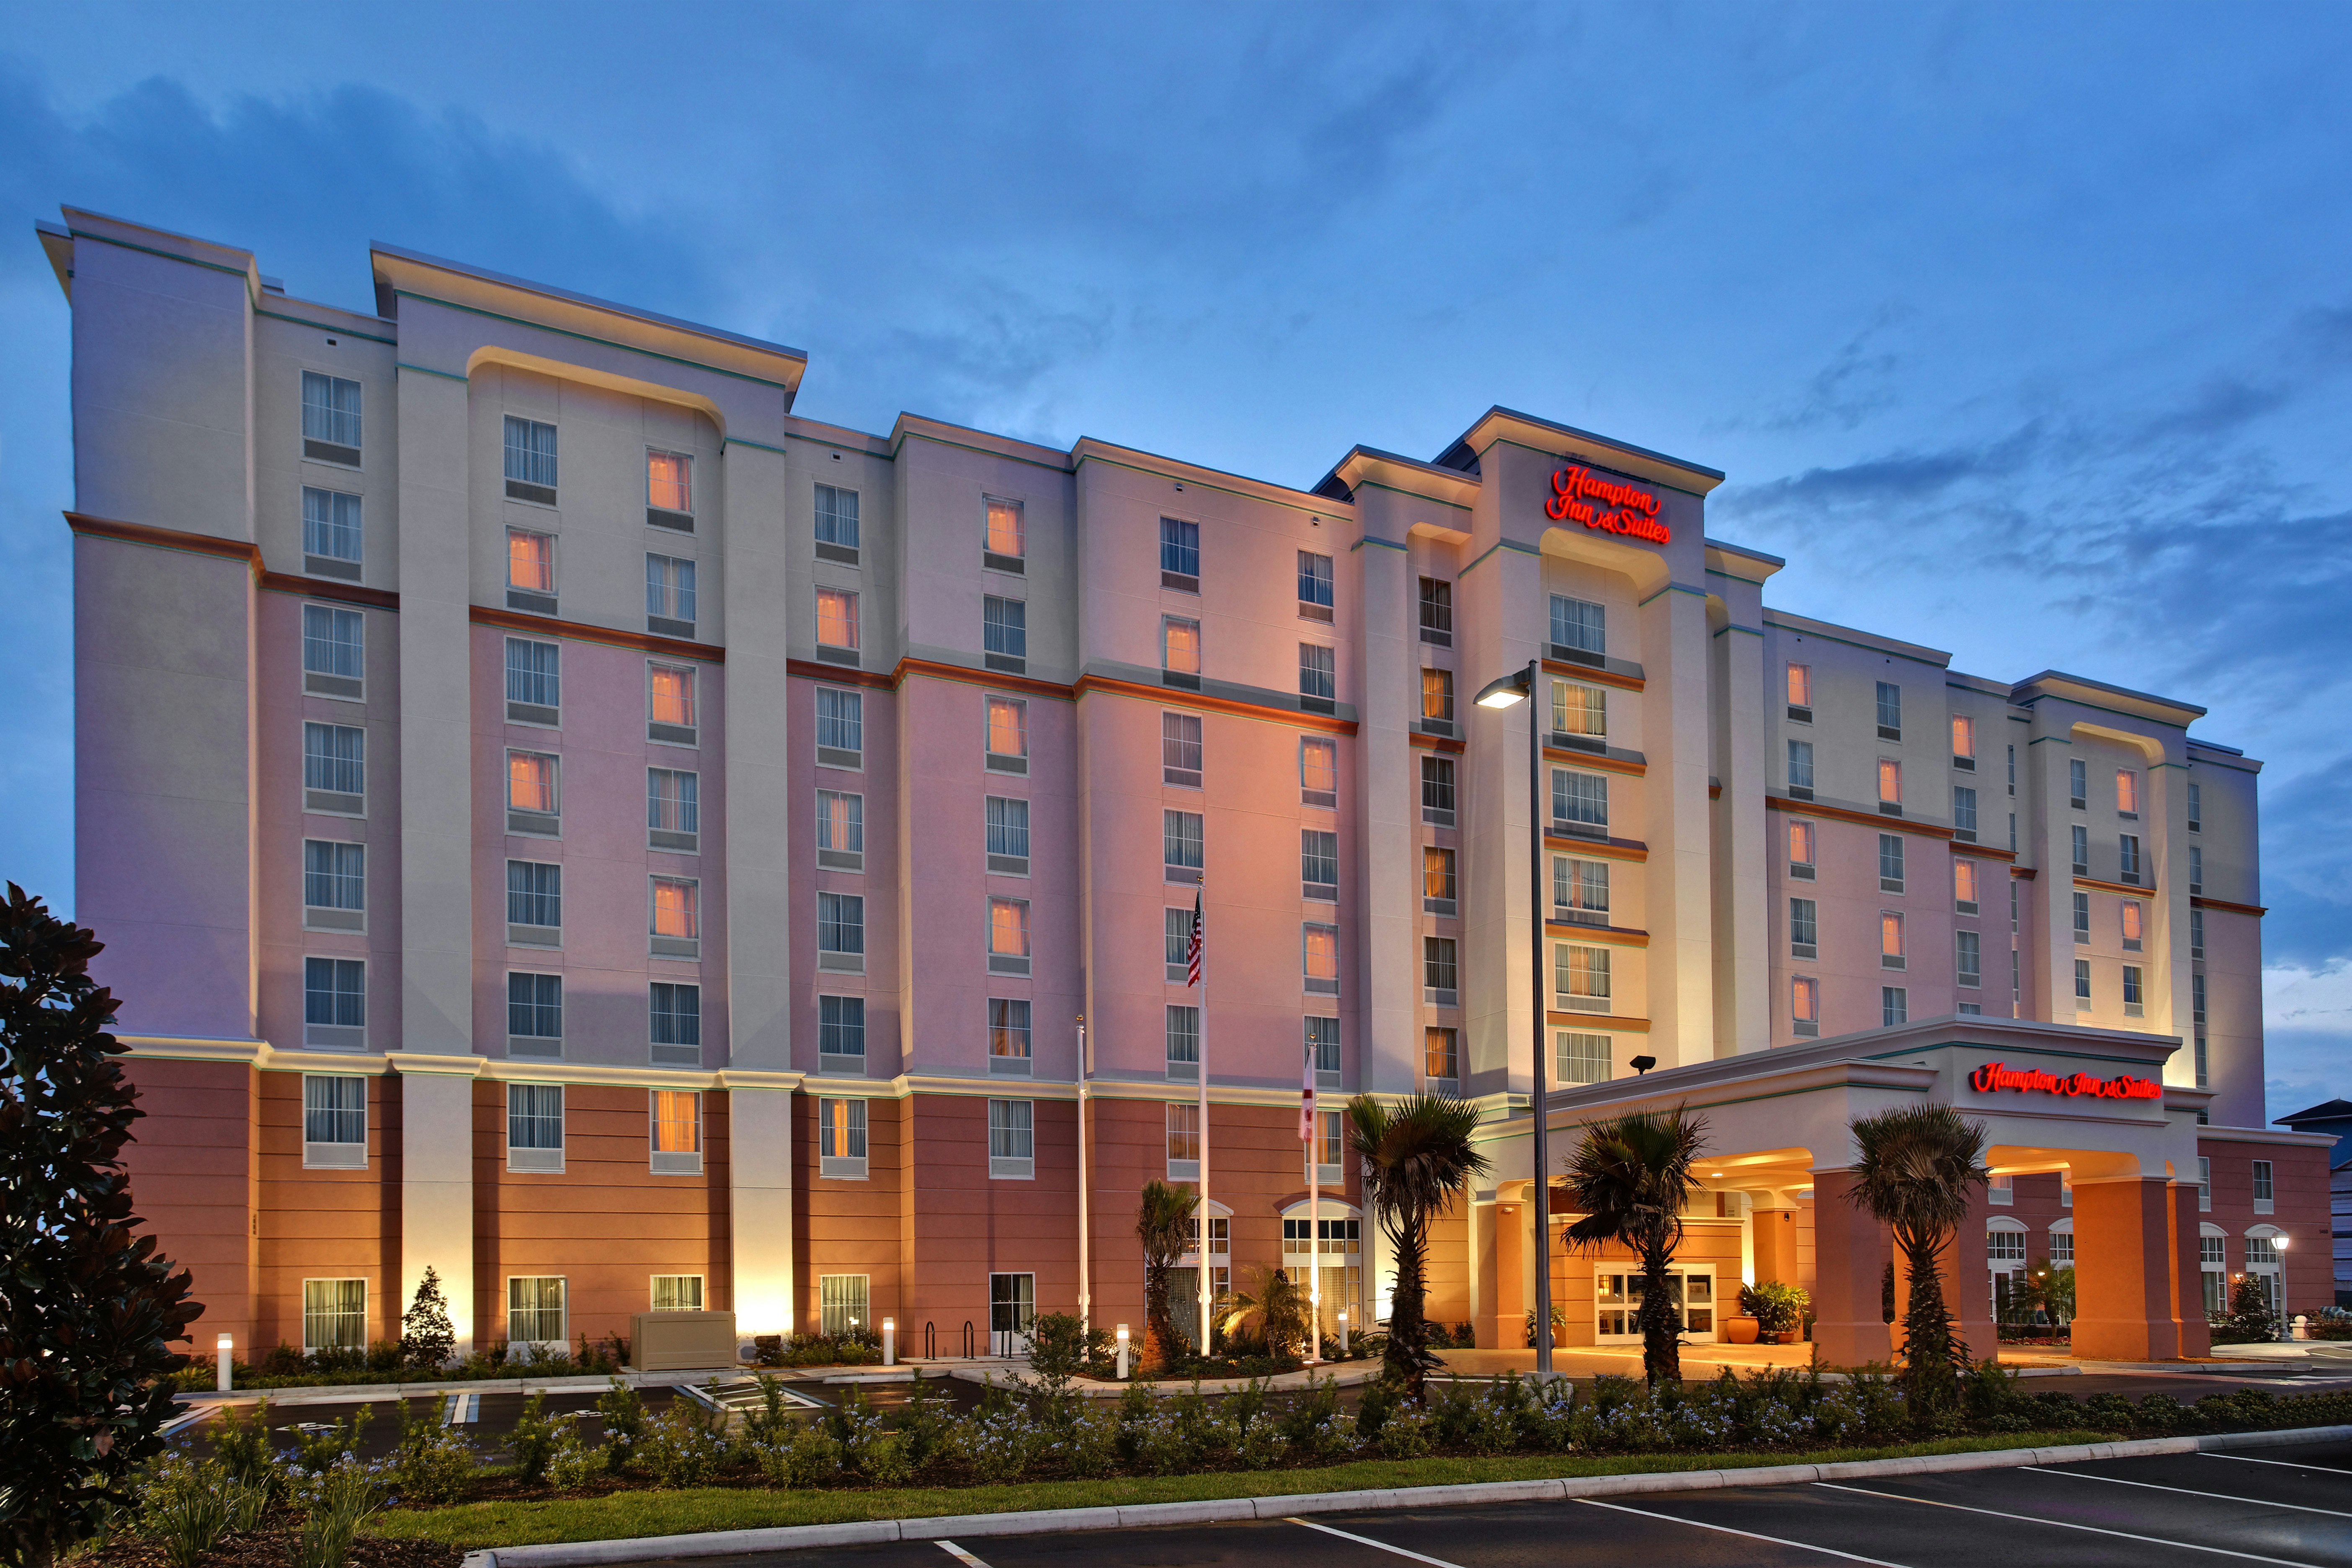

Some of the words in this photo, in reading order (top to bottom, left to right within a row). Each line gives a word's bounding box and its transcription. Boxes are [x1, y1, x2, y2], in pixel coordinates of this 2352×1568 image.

[1552, 466, 1661, 516] Hampton
[1545, 495, 1603, 528] Inn
[1601, 511, 1617, 534] &
[1614, 508, 1670, 544] Suites
[1973, 1062, 2064, 1094] Hampton
[2065, 1072, 2108, 1098] Inn
[2107, 1080, 2119, 1099] &
[2116, 1075, 2162, 1099] Suites
